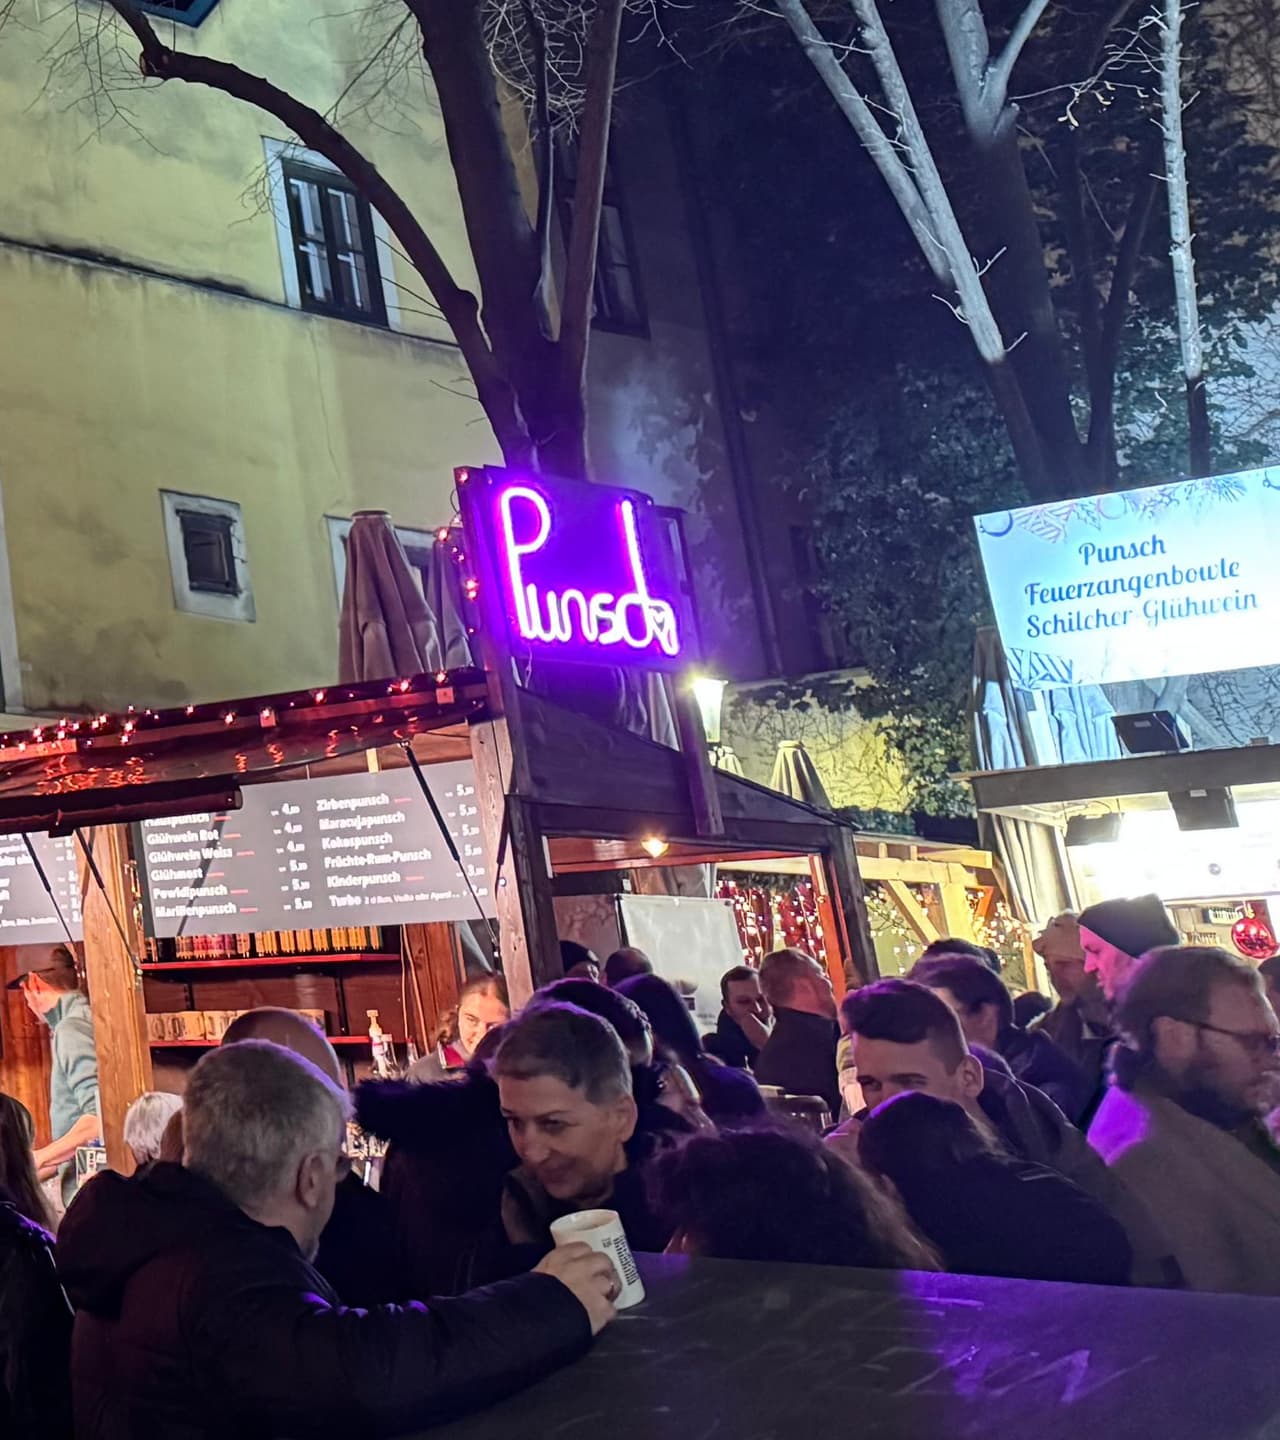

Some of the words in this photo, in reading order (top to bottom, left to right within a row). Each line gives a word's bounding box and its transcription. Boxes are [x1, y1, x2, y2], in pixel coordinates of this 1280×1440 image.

[1078, 534, 1167, 566] Punsch
[500, 486, 680, 657] Punsch
[1025, 557, 1240, 606] Feuerzangenbowle
[1026, 608, 1133, 639] Schilcher
[1143, 589, 1258, 627] Glühwein
[316, 793, 389, 811] Zirbenpunsch
[319, 811, 405, 830] Maracujapunsch
[147, 831, 199, 845] Glühwein
[200, 829, 219, 841] Rot
[322, 832, 392, 849] Kokospunsch
[149, 850, 200, 863] Glühwein
[324, 848, 432, 868] Früchte-Rum-Punsch
[151, 868, 203, 881] Glühmost
[327, 871, 400, 888] Kinderpunsch
[329, 895, 361, 907] Turbo
[155, 903, 237, 918] Marillenpunsch
